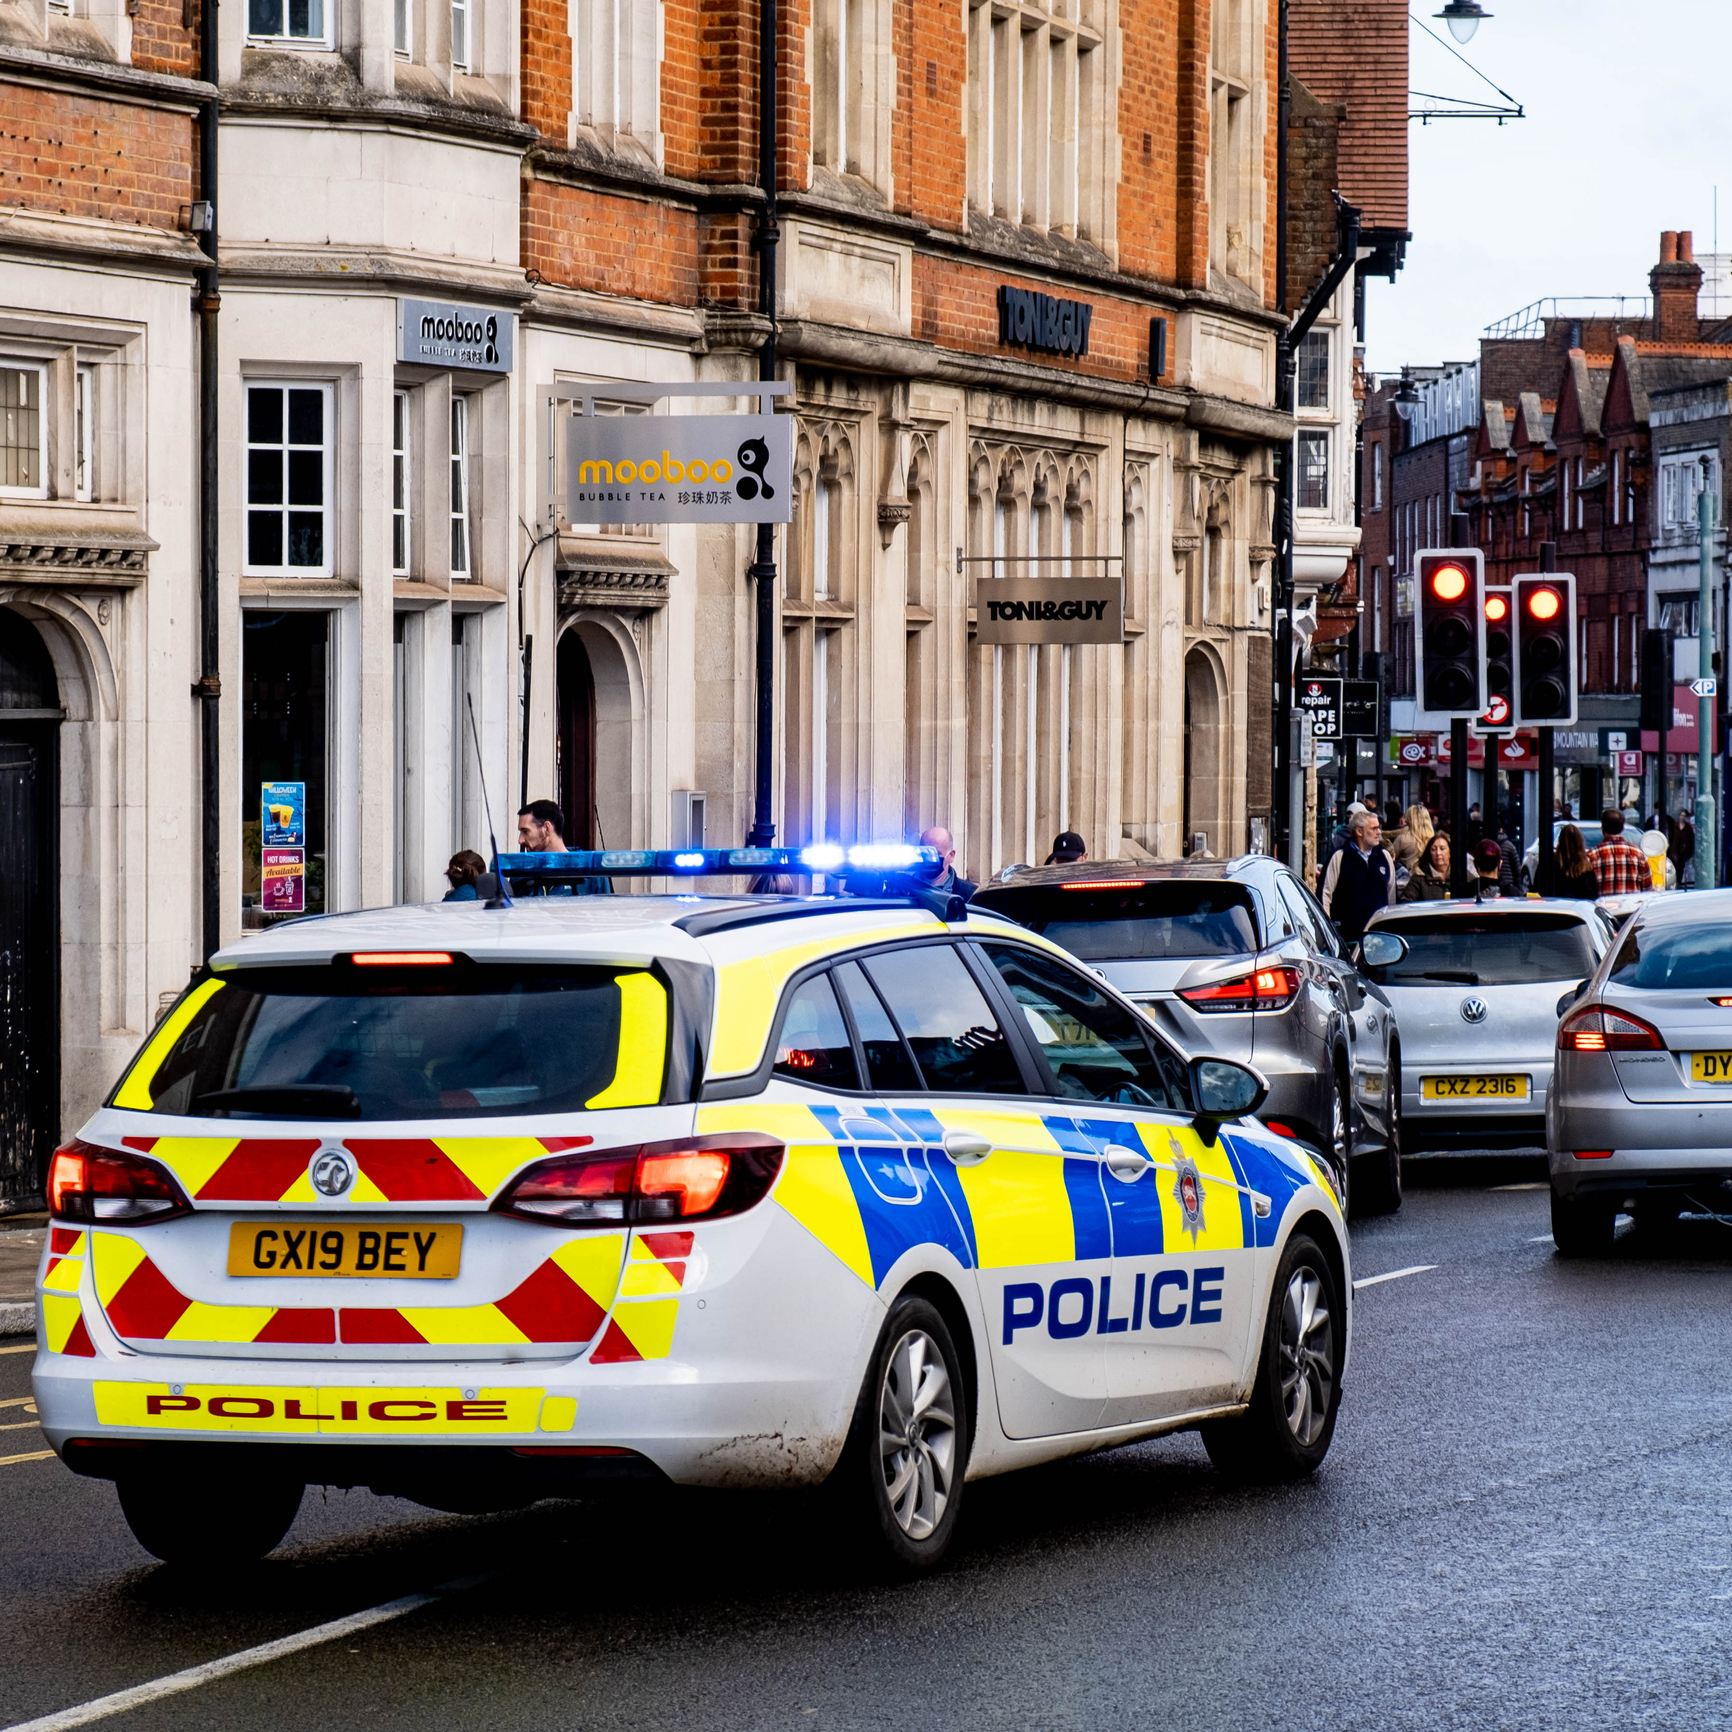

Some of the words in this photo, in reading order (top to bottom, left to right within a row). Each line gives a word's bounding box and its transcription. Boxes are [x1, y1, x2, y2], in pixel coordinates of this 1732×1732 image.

[420, 310, 483, 344] mooboo
[1000, 285, 1093, 356] TONI&GUY
[579, 450, 733, 484] mooboo
[579, 492, 631, 501] BUBBLE
[640, 492, 666, 501] TEA
[677, 490, 732, 505] 珍珠奶茶
[987, 600, 1108, 621] TONI&GUY
[1301, 695, 1332, 707] repair
[1307, 709, 1336, 722] APE
[1313, 723, 1337, 735] OP
[1556, 732, 1588, 748] MOUNTAIN
[1589, 732, 1599, 748] WA
[267, 855, 278, 864] HOT
[278, 855, 299, 864] DRINKS
[266, 866, 301, 877] Available
[1435, 1079, 1471, 1096] CXZ
[1476, 1077, 1516, 1095] 2316
[253, 1230, 344, 1270] GX19
[355, 1231, 437, 1271] BEY
[1002, 1267, 1225, 1346] POLICE
[146, 1395, 508, 1422] POLICE
